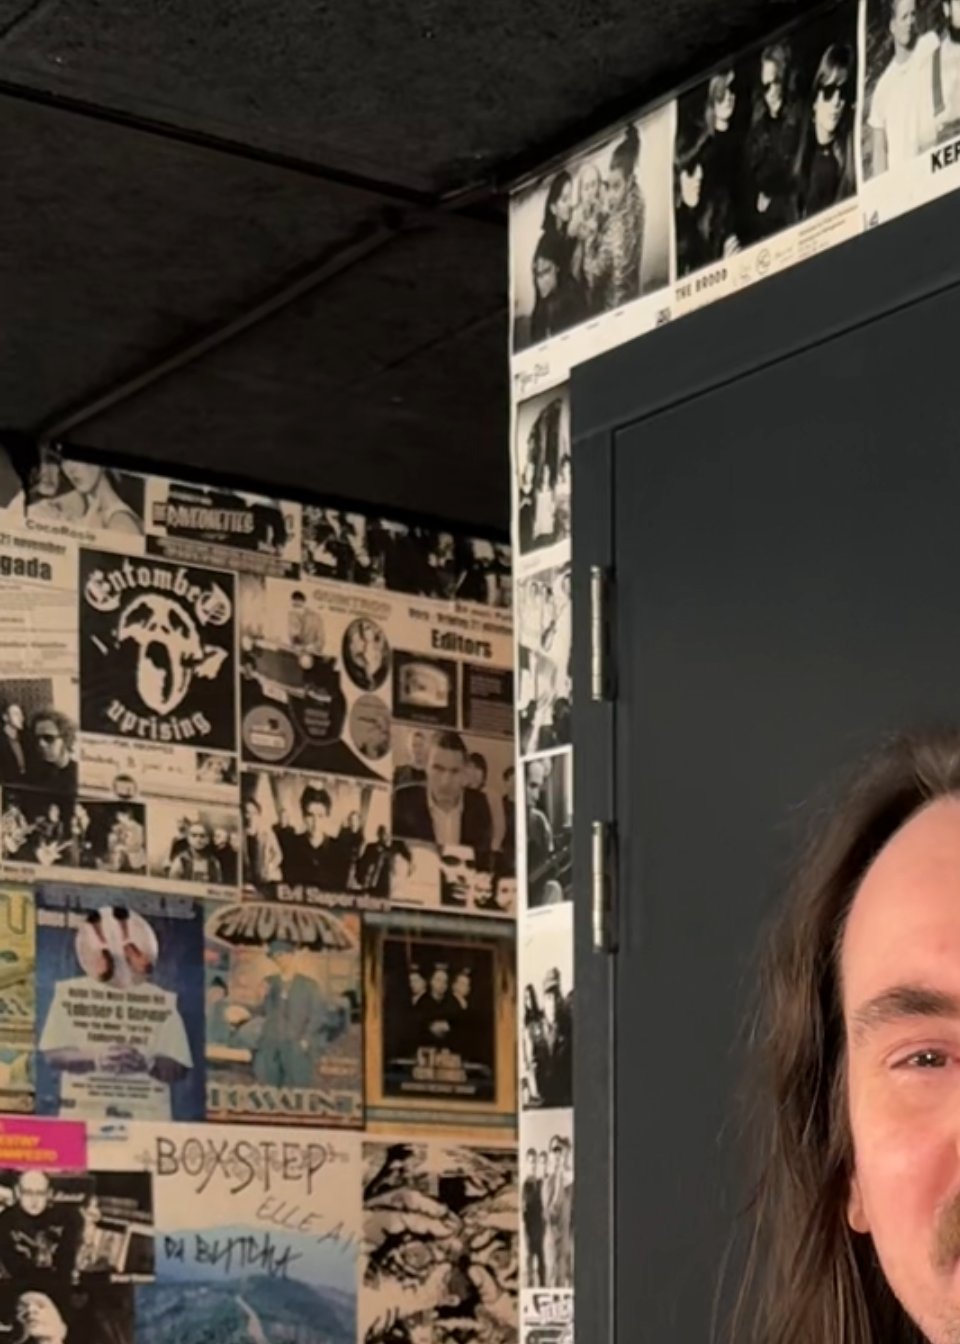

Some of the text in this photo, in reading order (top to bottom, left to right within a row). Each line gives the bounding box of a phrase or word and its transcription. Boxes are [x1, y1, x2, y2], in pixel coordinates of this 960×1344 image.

[431, 629, 493, 659] Editors
[106, 699, 212, 742] uprising
[155, 1136, 328, 1195] BOXSTEP
